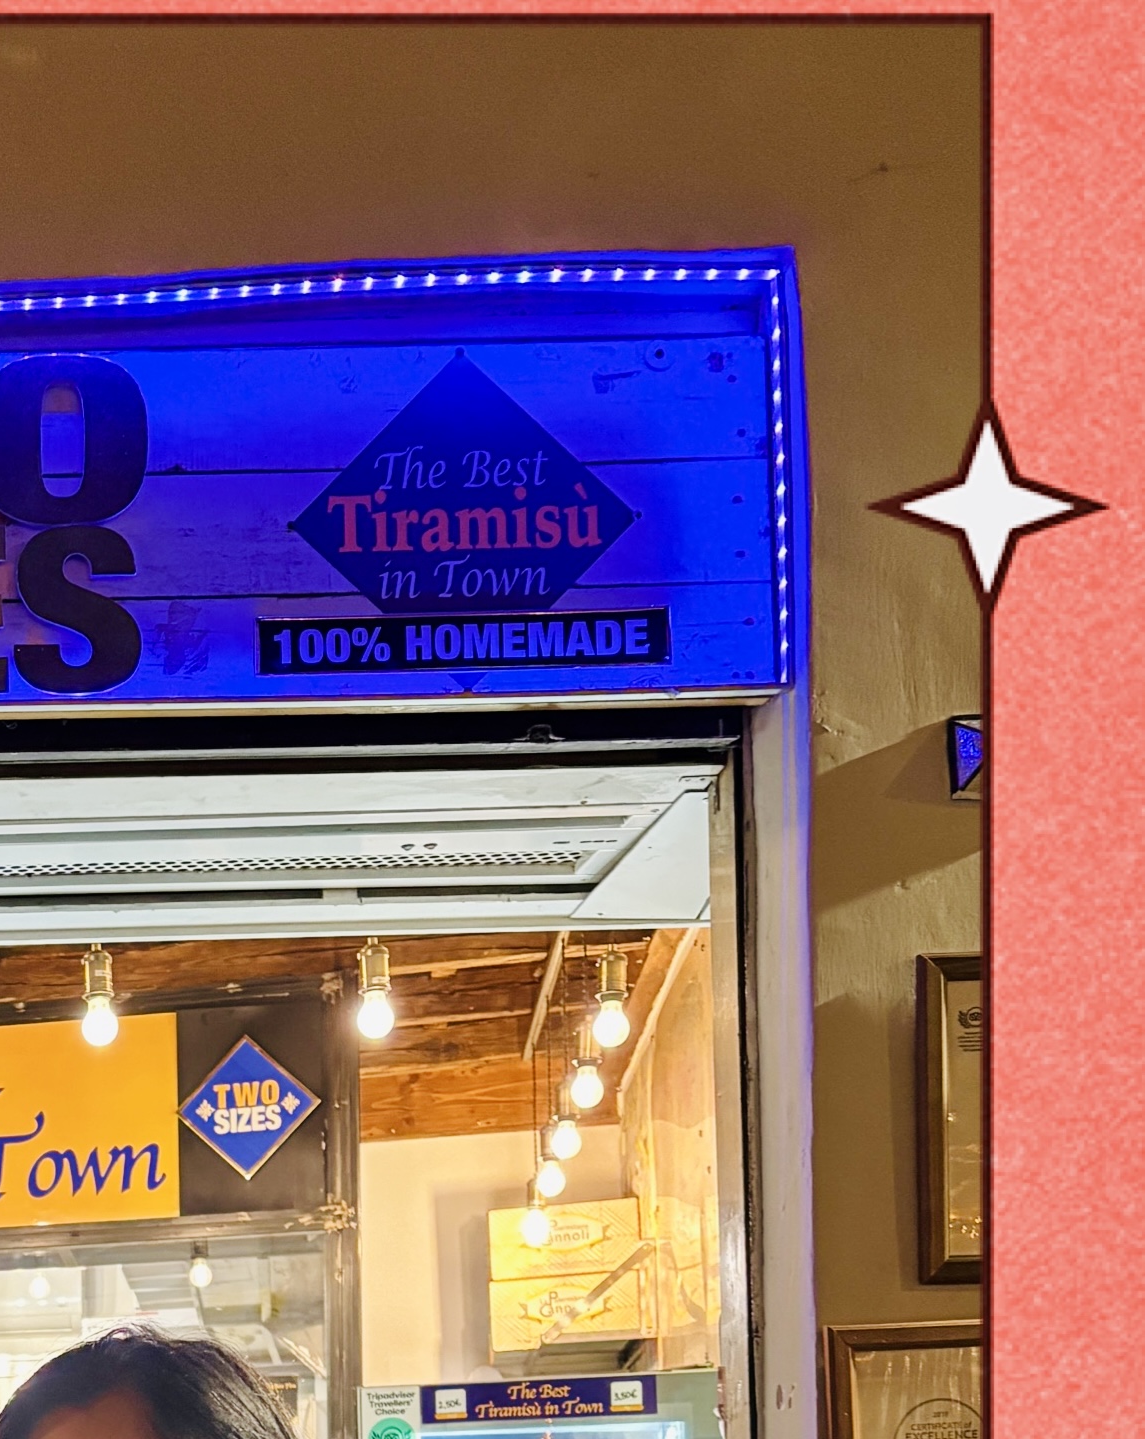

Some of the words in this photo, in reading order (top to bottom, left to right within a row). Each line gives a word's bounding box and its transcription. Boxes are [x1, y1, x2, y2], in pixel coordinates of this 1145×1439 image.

[373, 445, 448, 490] The
[462, 450, 548, 488] Best
[327, 482, 603, 553] Tiramisù
[378, 560, 421, 600] in
[433, 554, 551, 599] Town
[273, 627, 391, 665] 100%
[405, 618, 651, 661] HOMEMADE
[213, 1078, 281, 1107] TWO
[213, 1105, 283, 1135] SIZES
[367, 1391, 415, 1400] Tripadvisor
[507, 1382, 537, 1400] The
[539, 1384, 571, 1399] Best
[375, 1408, 406, 1416] Choice
[475, 1400, 542, 1419] Tiramisù
[544, 1401, 559, 1416] in
[562, 1396, 605, 1415] Town
[911, 1422, 963, 1431] CERTIFICATE
